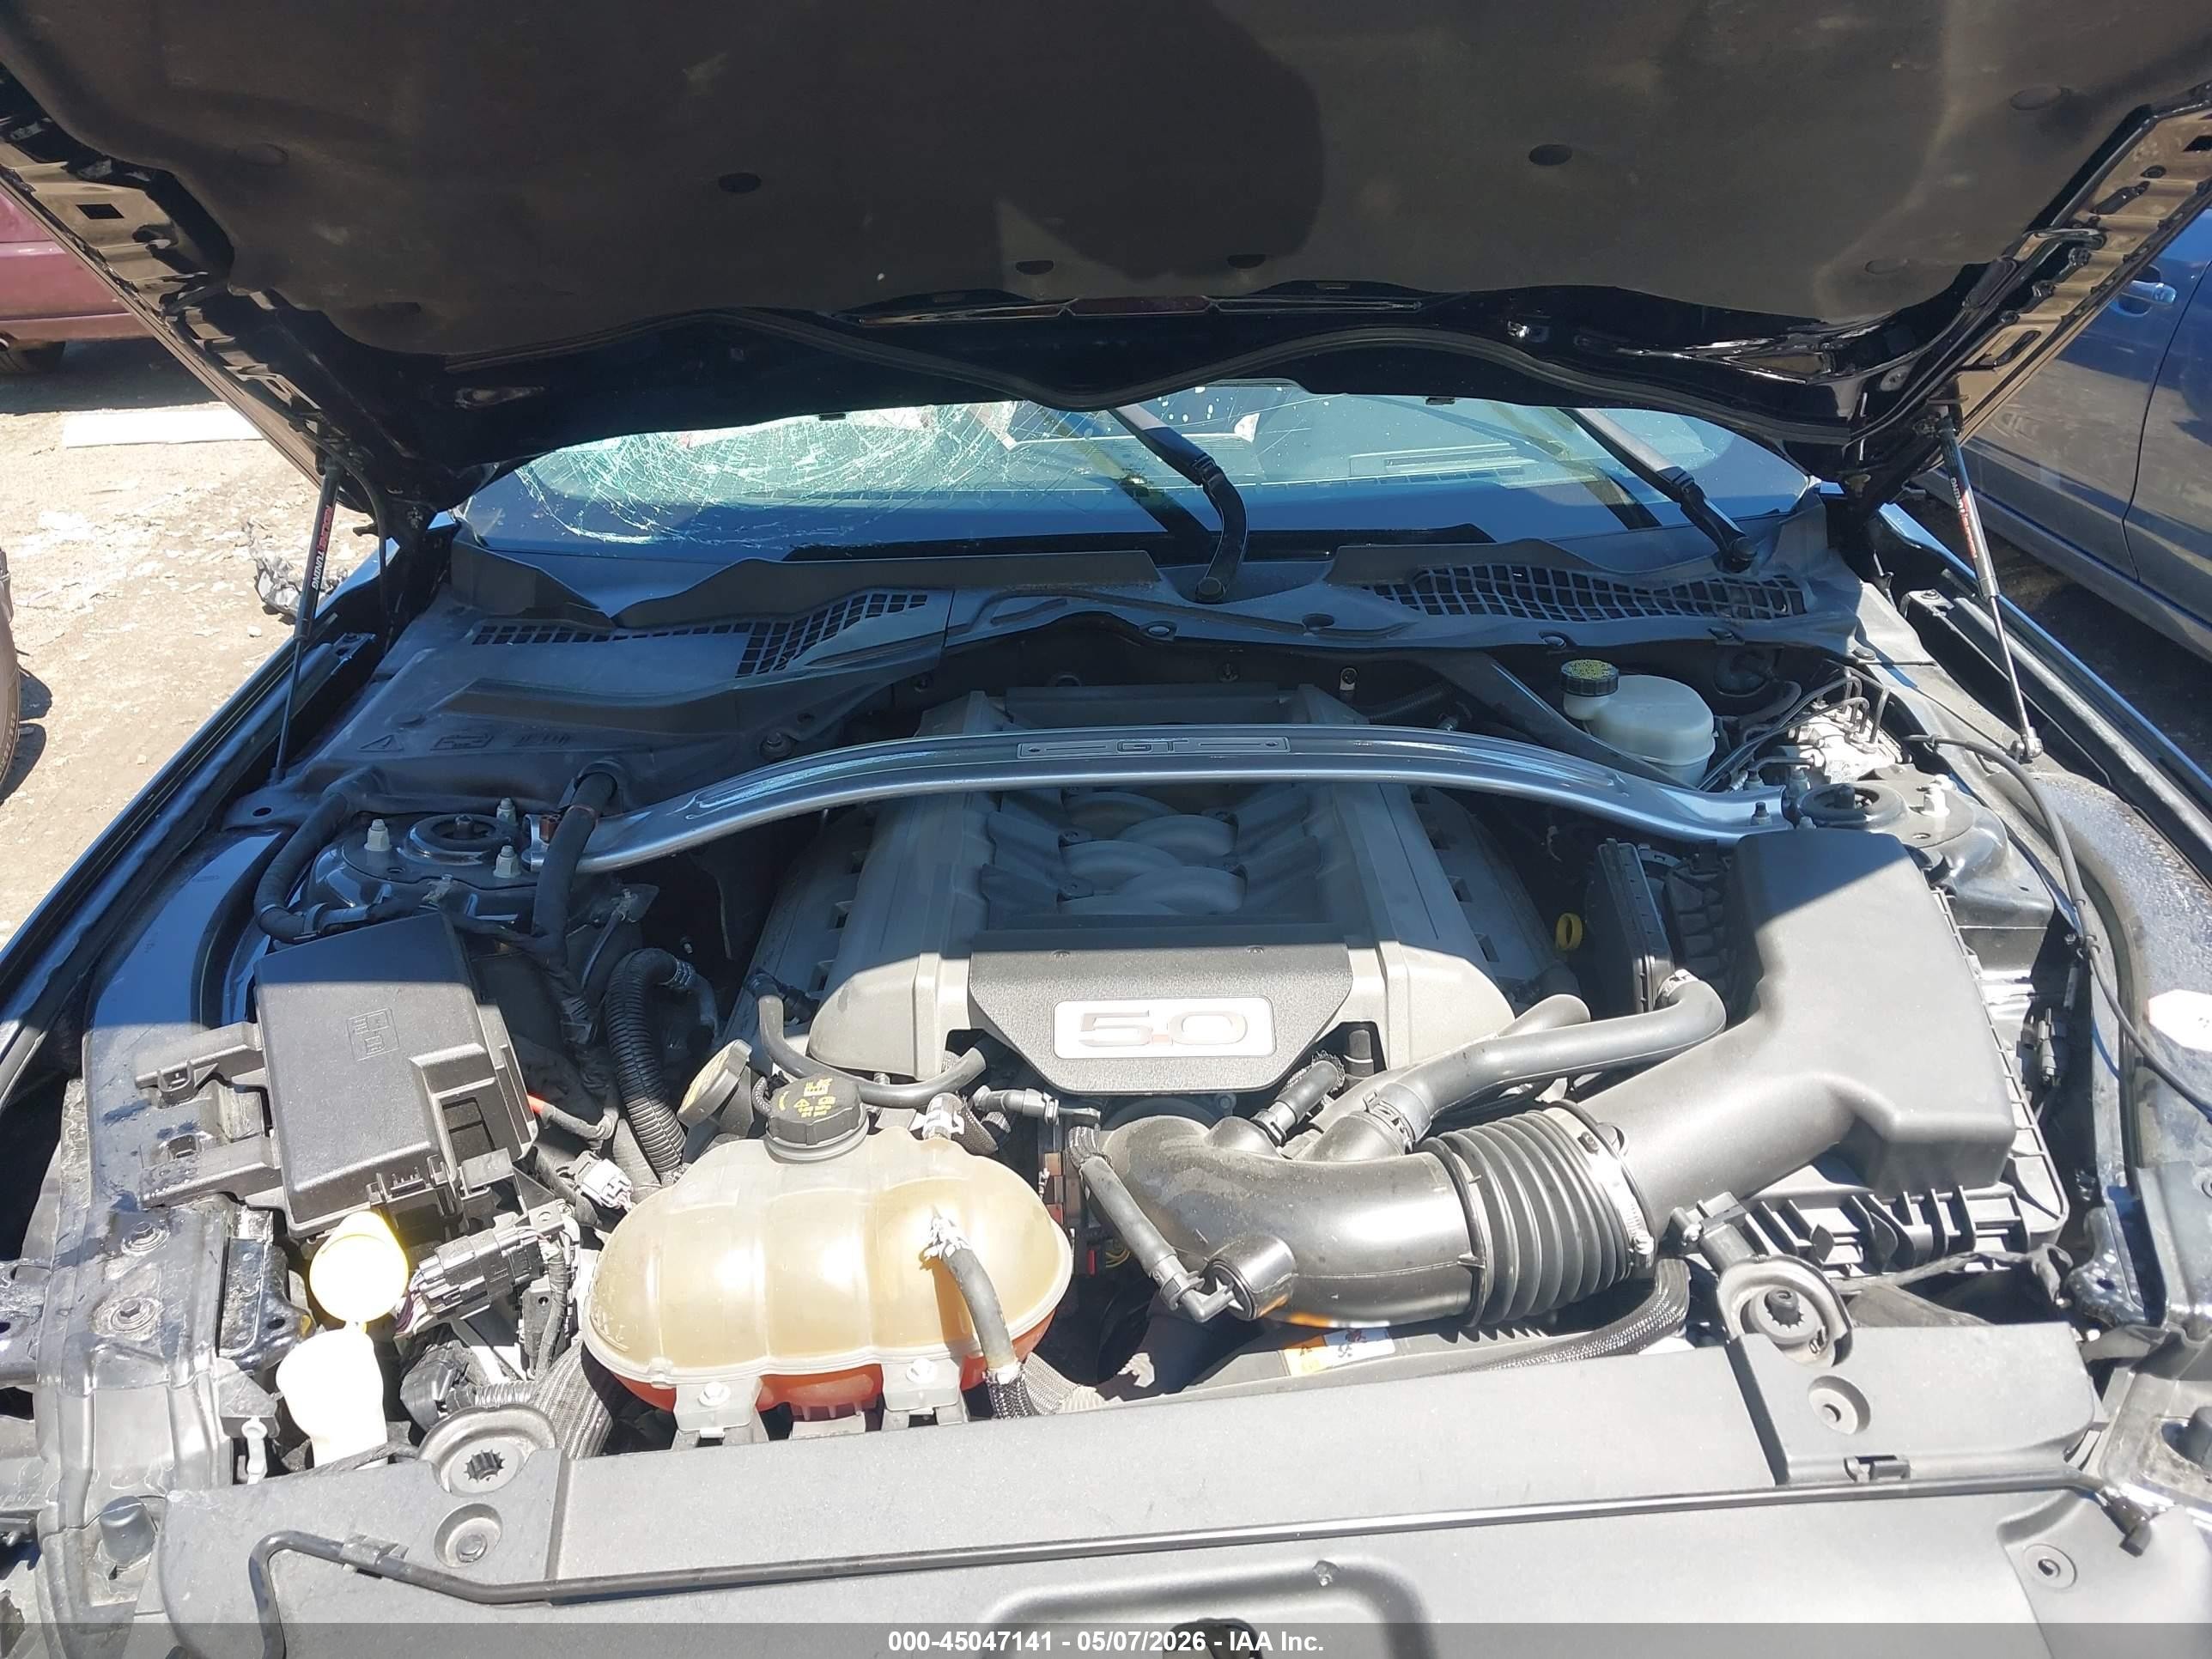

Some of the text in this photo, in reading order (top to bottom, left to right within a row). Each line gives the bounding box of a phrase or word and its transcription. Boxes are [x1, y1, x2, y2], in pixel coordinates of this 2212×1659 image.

[311, 550, 325, 591] TUNING
[1116, 738, 1189, 753] GT
[1078, 1009, 1249, 1048] 5.0
